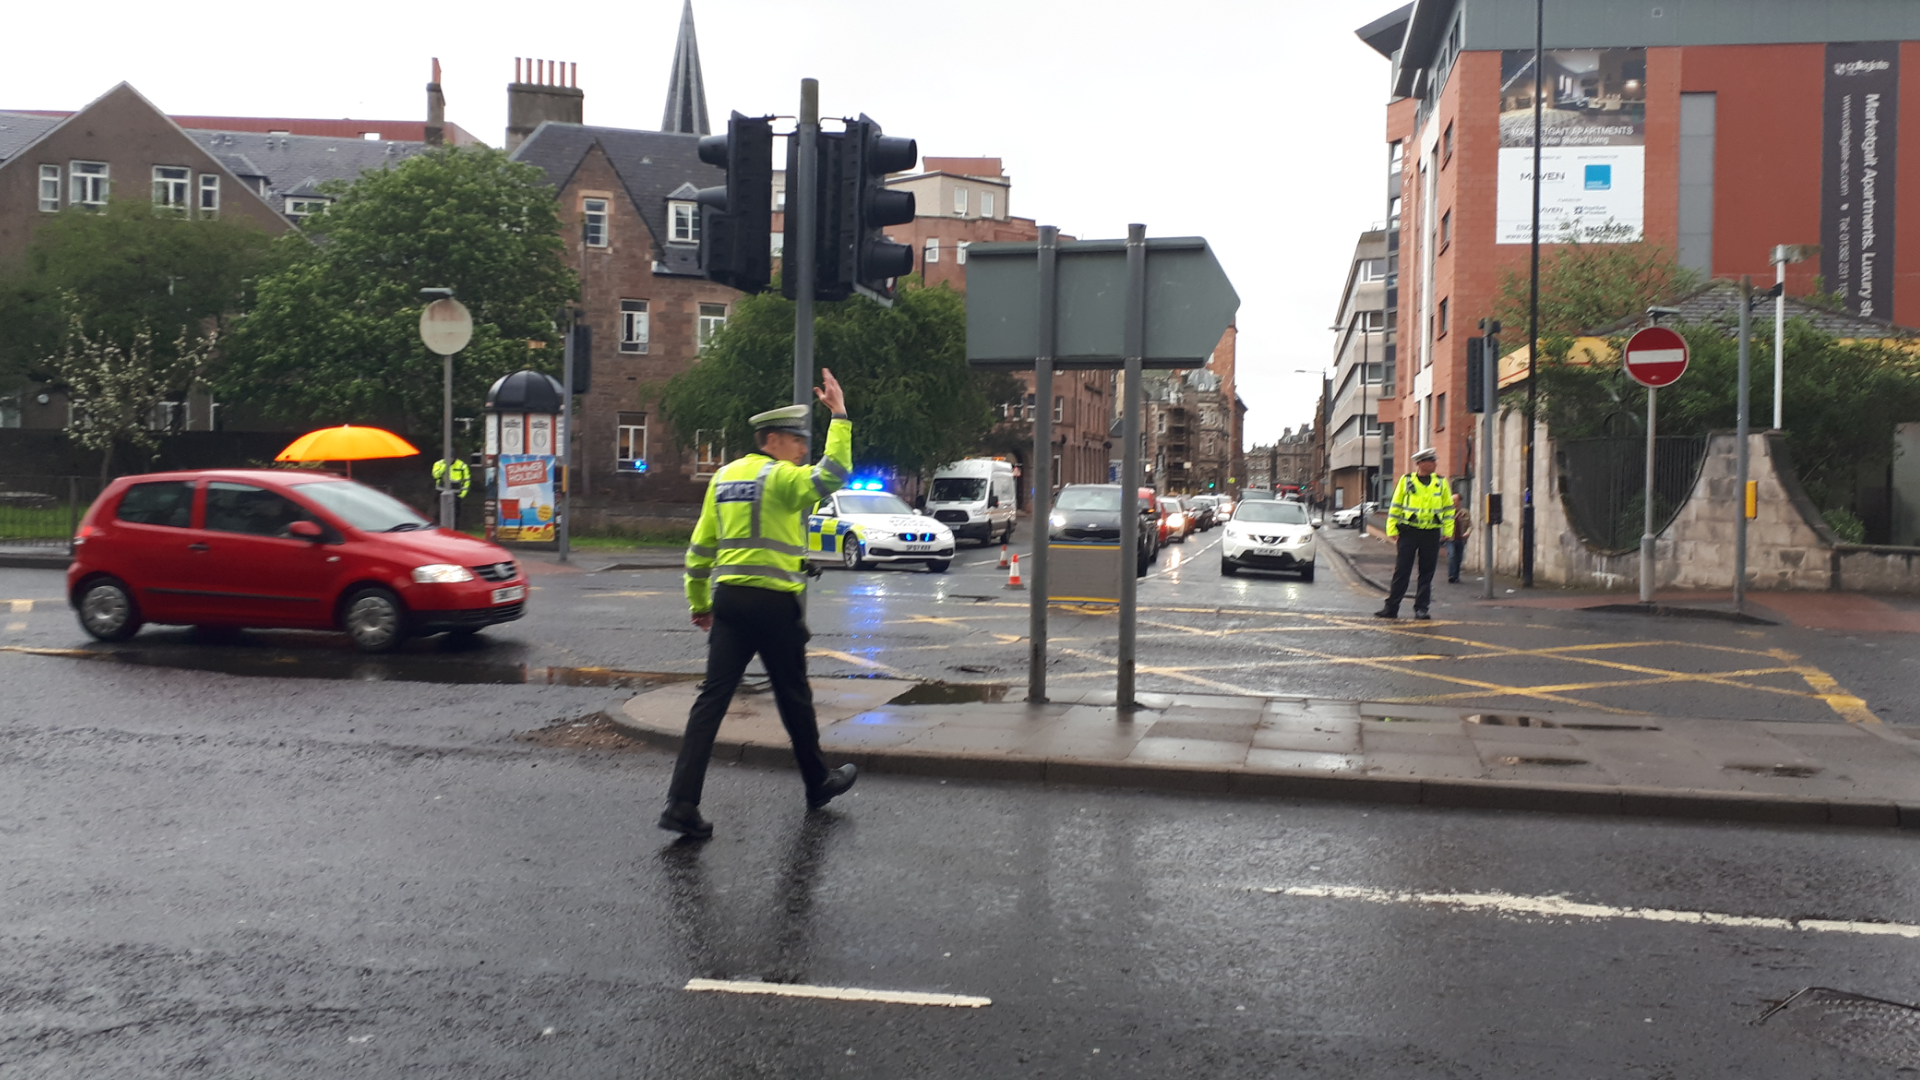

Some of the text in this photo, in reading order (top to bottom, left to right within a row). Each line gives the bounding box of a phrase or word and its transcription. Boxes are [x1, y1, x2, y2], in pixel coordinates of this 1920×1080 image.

[1571, 126, 1634, 135] APARTMENTS
[1861, 93, 1881, 167] Marketgait
[1857, 251, 1877, 298] Luxury
[507, 461, 543, 474] SUMMER
[508, 470, 544, 481] HOLIDAY
[715, 483, 756, 500] POLICE
